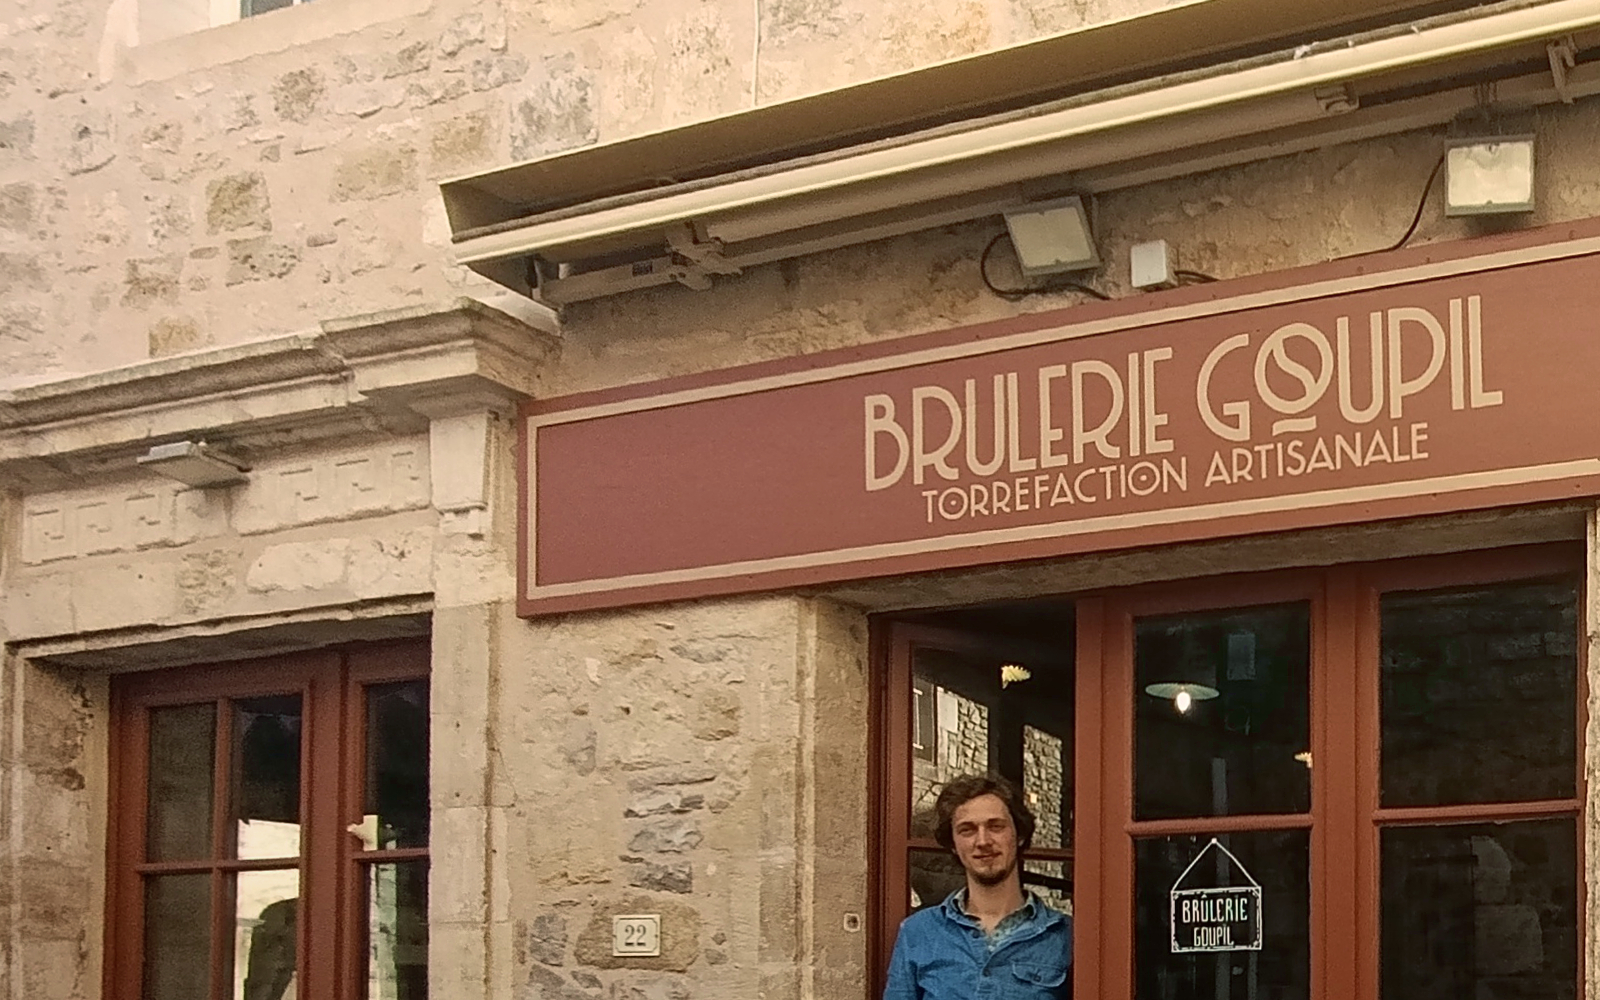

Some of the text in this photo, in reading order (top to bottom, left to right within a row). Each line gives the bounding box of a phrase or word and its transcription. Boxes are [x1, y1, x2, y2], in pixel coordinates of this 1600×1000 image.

[863, 294, 1503, 491] BRULERIE GOUPIL
[922, 422, 1430, 523] TORREFACTION ARTISANALE
[624, 924, 647, 947] 22
[1193, 924, 1234, 947] GOUPIL
